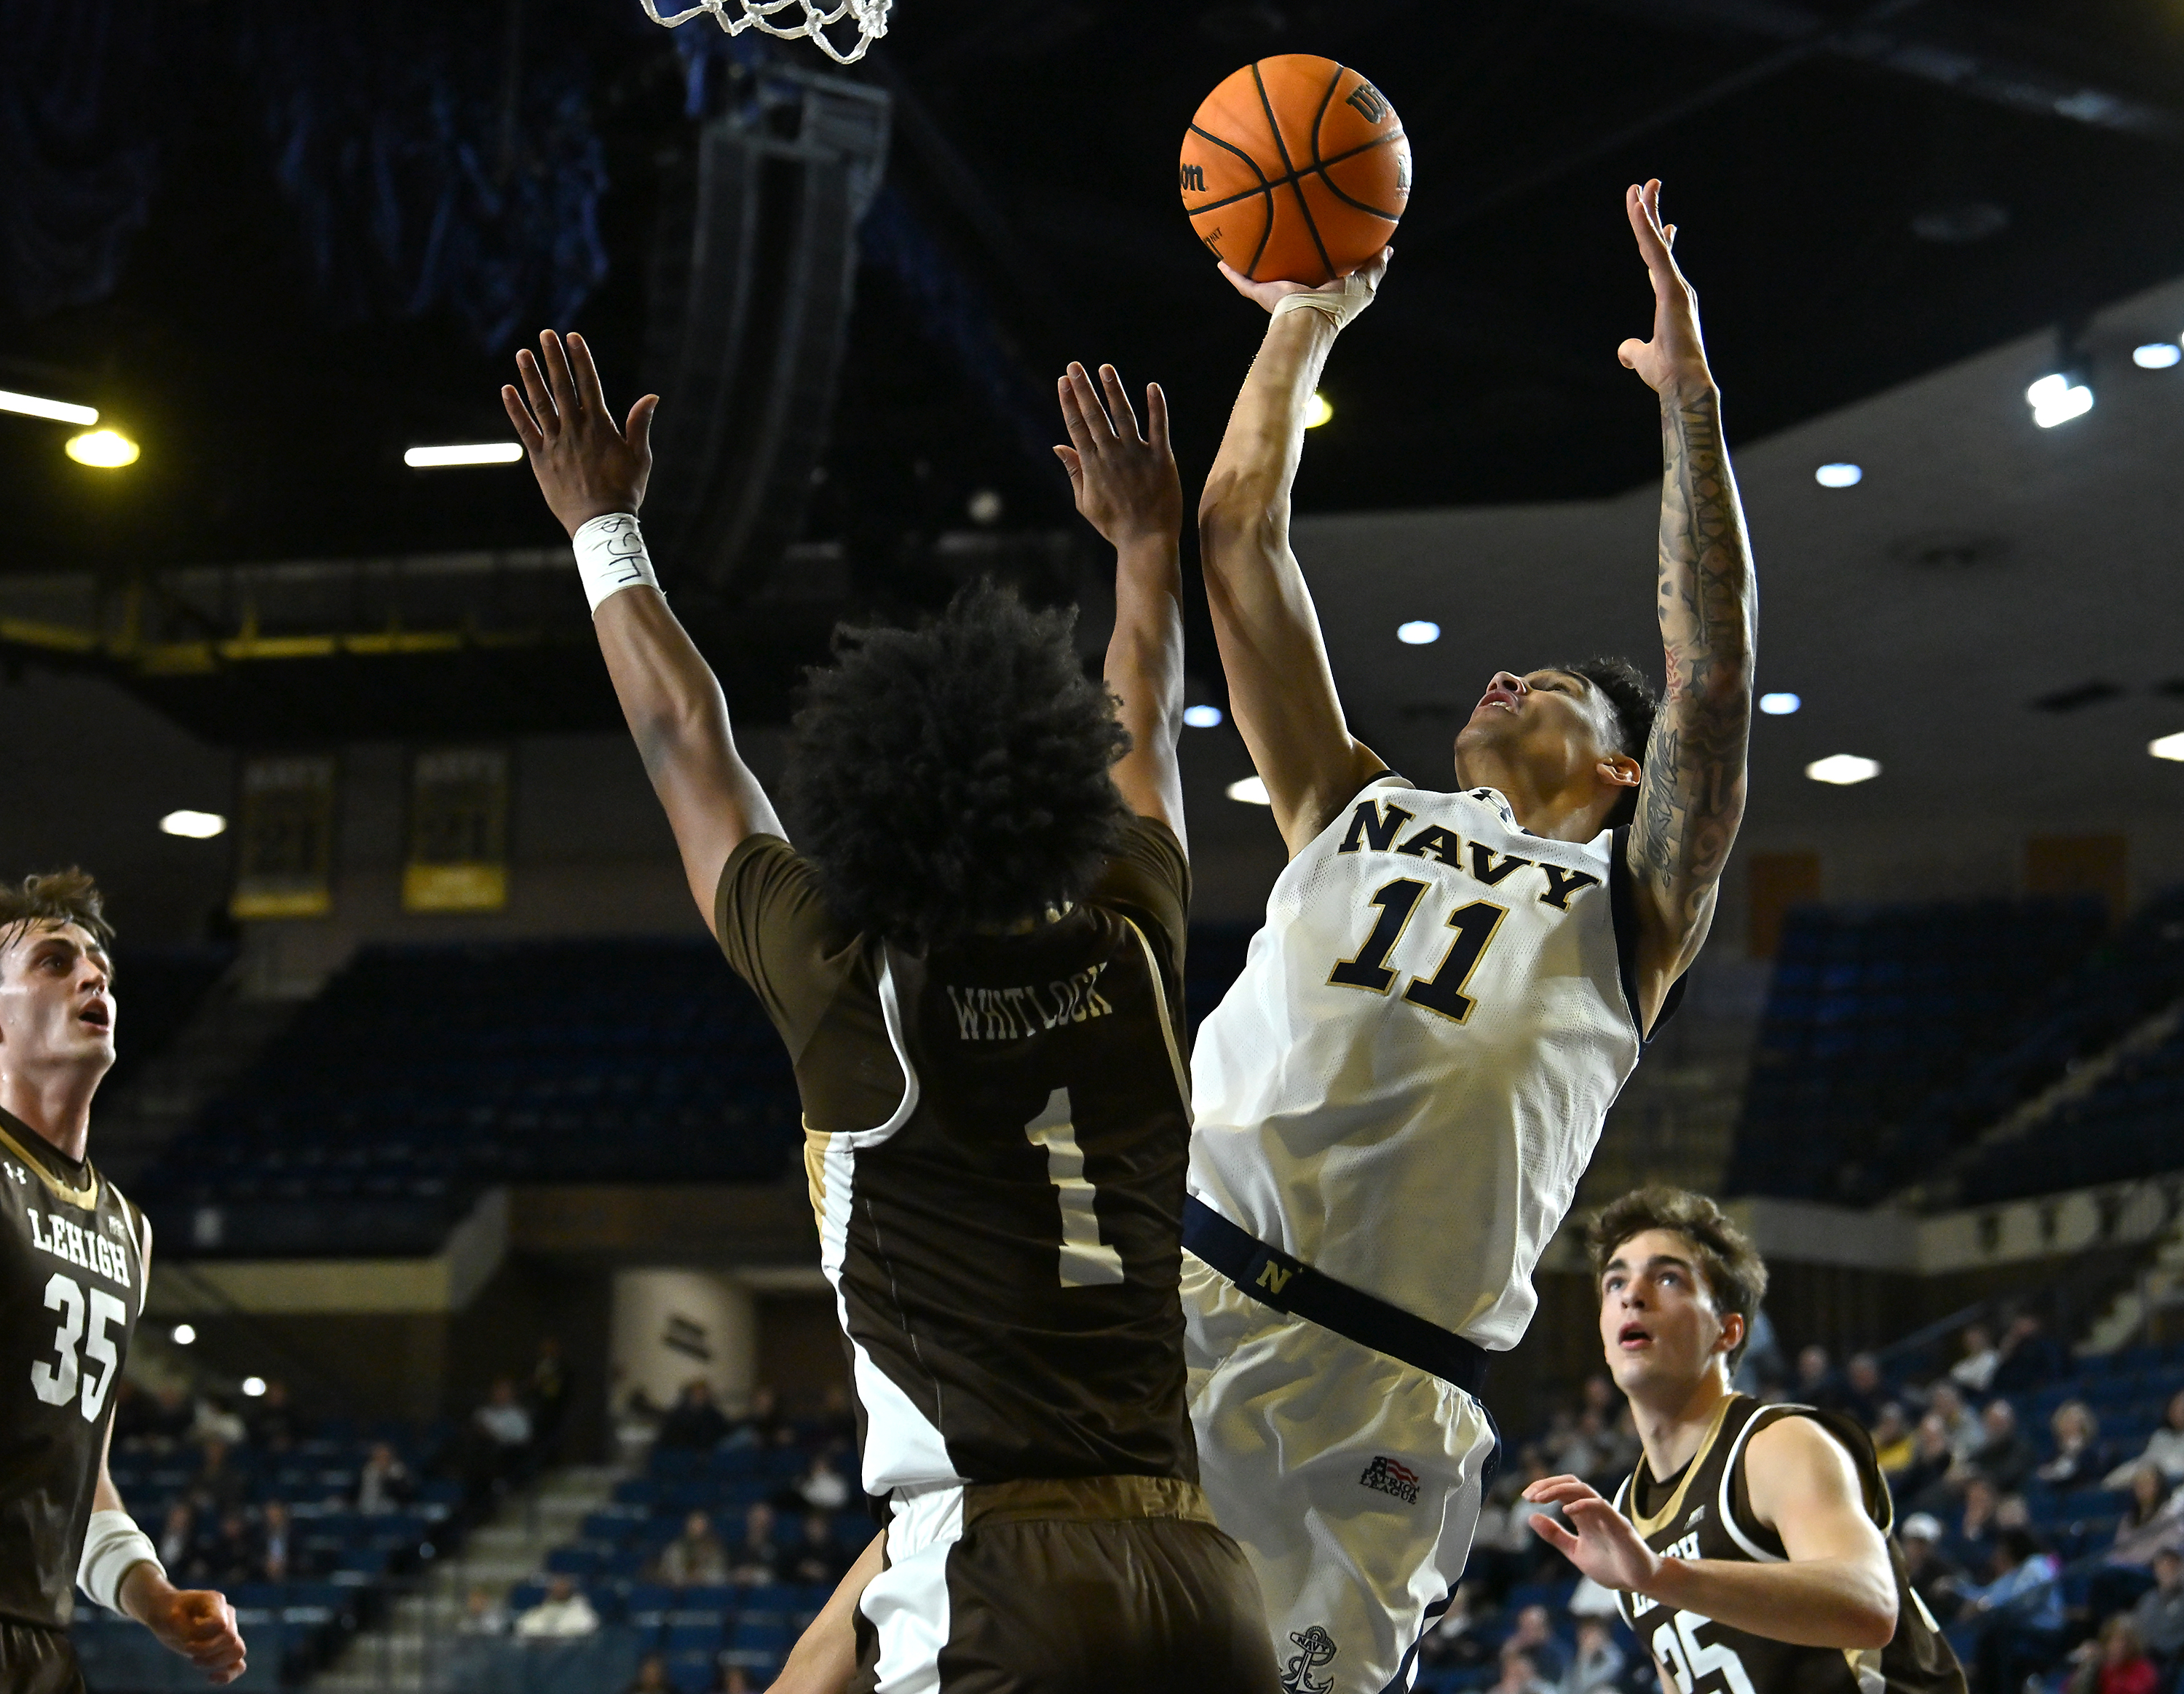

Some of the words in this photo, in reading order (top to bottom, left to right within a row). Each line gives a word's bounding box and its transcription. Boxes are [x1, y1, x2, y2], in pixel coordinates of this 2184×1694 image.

[1338, 799, 1602, 912] NAVY
[1325, 876, 1510, 1025] 11
[946, 961, 1113, 1040] WHITLOCK
[1024, 1086, 1125, 1288] 1
[27, 1207, 131, 1288] LEHIGH
[1255, 1259, 1294, 1295] N
[30, 1272, 126, 1423] 35
[1360, 1477, 1417, 1505] LEAGUE
[1362, 1468, 1420, 1495] PATRIOT
[1297, 1636, 1328, 1652] NAVY
